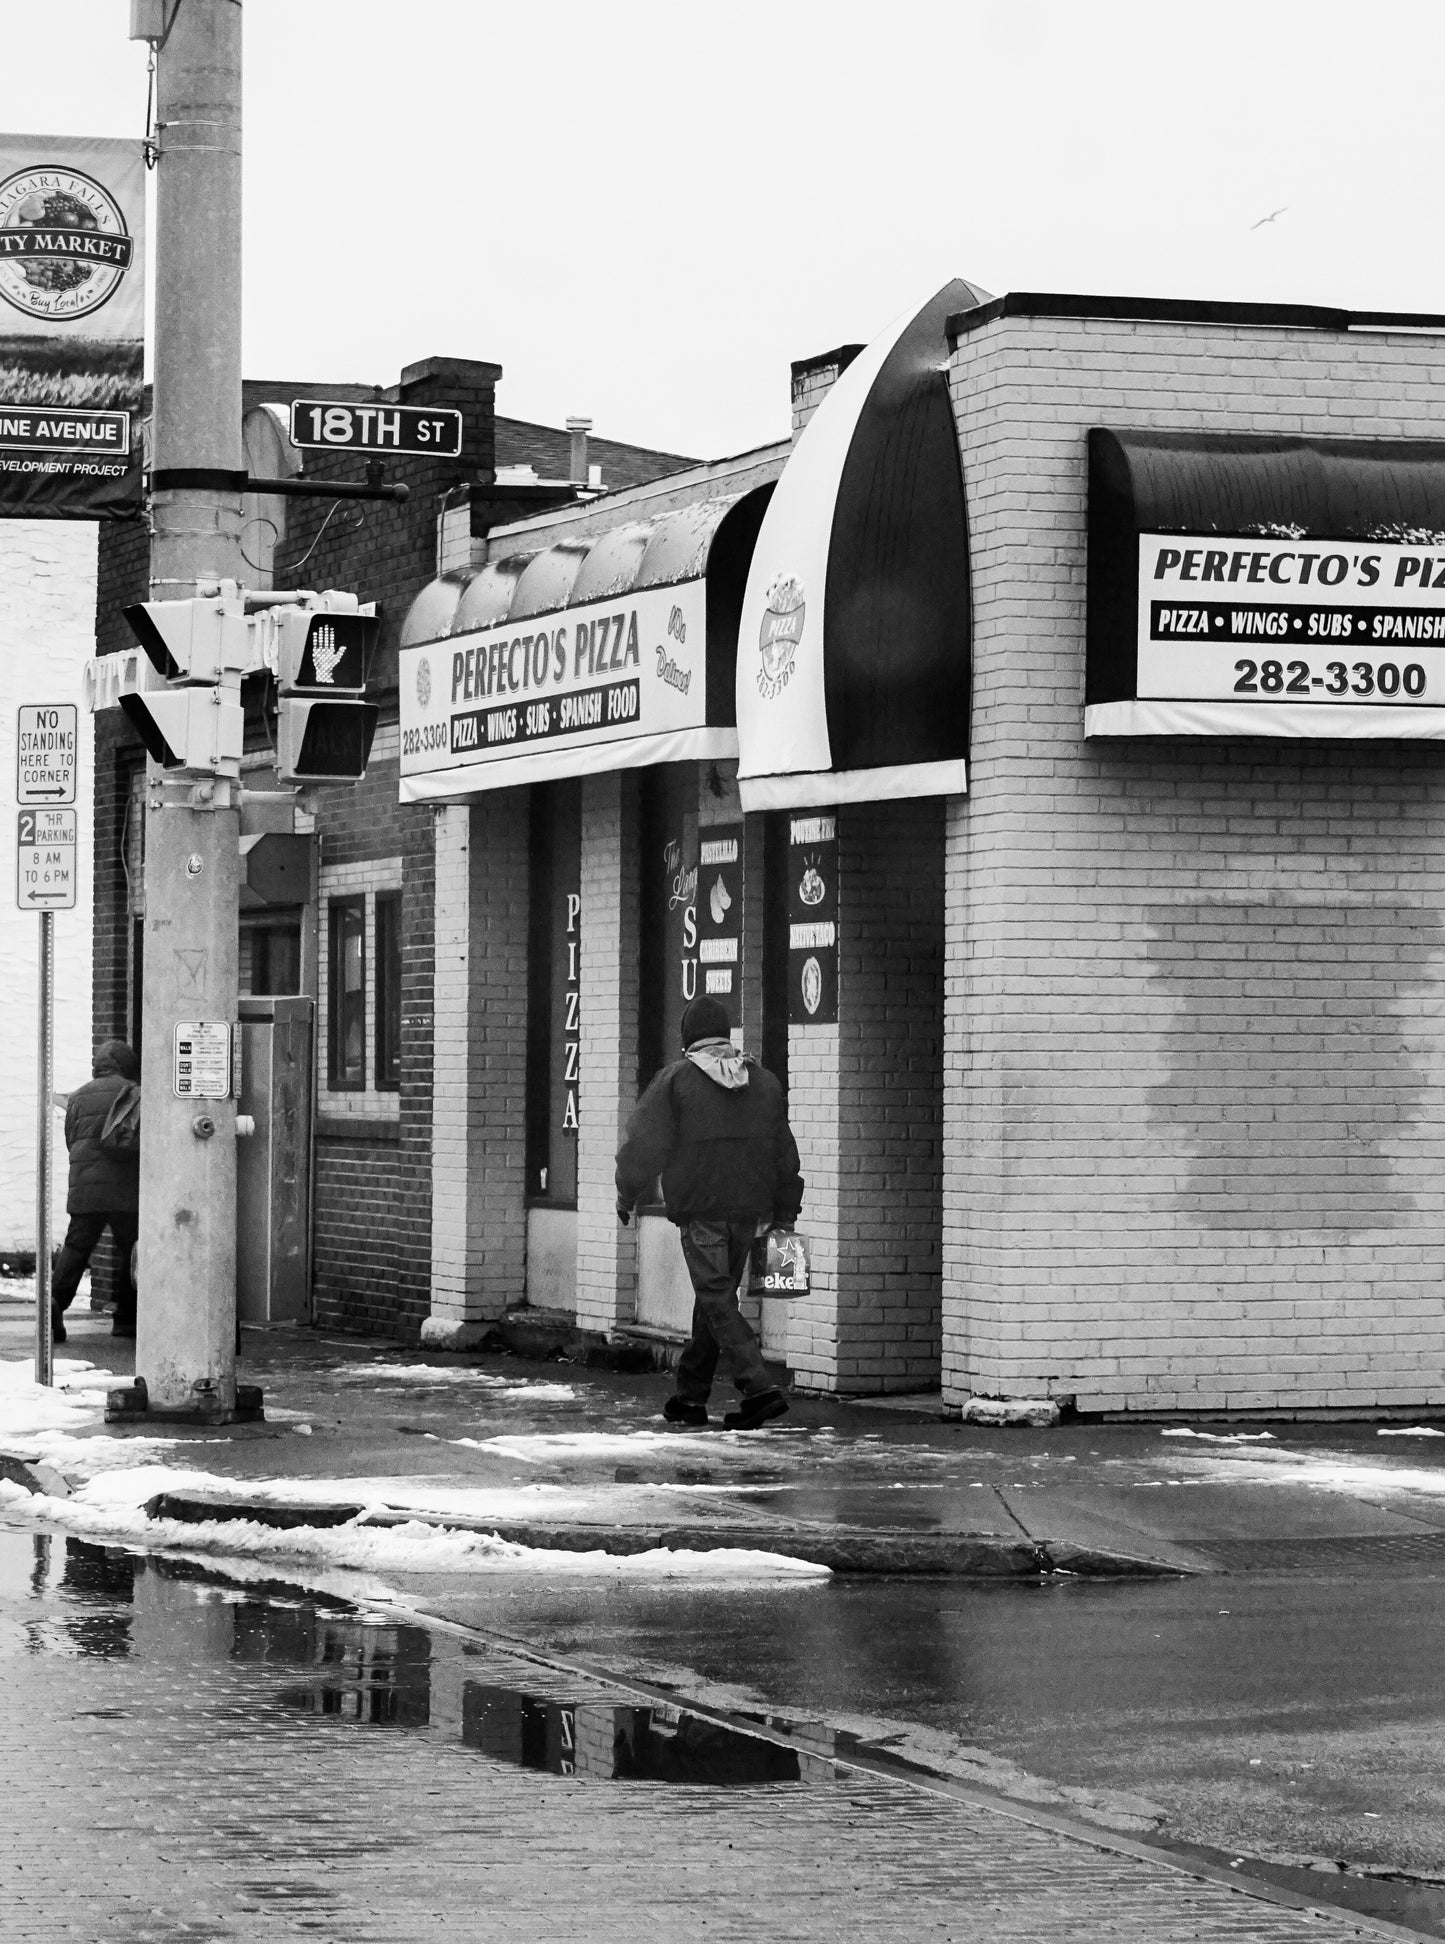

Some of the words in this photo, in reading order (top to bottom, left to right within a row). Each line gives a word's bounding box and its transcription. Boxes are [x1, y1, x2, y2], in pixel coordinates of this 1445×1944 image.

[0, 176, 61, 216] IAGARA
[69, 180, 111, 225] FALLS
[34, 234, 126, 260] MARKET
[30, 290, 51, 315] Buy
[54, 292, 79, 312] Local
[35, 420, 117, 441] AVENUE
[309, 407, 400, 446] 18TH
[417, 419, 445, 443] ST
[73, 463, 128, 476] PROJECT
[1153, 548, 1382, 587] PERFECTO'S
[1158, 609, 1209, 633] PIZZA
[1231, 611, 1289, 635] WINGS
[1307, 613, 1353, 637] SUBS
[1371, 615, 1445, 640] SPANISH
[451, 626, 568, 706] PERFECTO'S
[573, 609, 641, 681] PIZZA
[756, 660, 795, 700] 282-3300
[1233, 658, 1428, 699] 282-3300
[36, 710, 59, 729] NO
[453, 717, 479, 749] PIZZA
[487, 708, 517, 742] WINGS
[525, 702, 550, 735] SUBS
[559, 691, 602, 729] SPANISH
[607, 684, 638, 720] FOOD
[21, 731, 73, 751] STANDING
[402, 722, 448, 756] 282-3300
[20, 754, 49, 767] HERE
[60, 753, 73, 766] TO
[24, 769, 70, 783] CORNER
[20, 815, 34, 842] 2
[48, 813, 63, 826] HR
[37, 829, 74, 842] PARKING
[33, 852, 39, 865] 8
[45, 852, 61, 865] AM
[25, 870, 38, 883] TO
[44, 870, 50, 883] 6
[54, 869, 69, 882] PM
[681, 905, 698, 1001] SU
[562, 893, 581, 1128] PIZZA
[764, 1272, 801, 1290] eke
